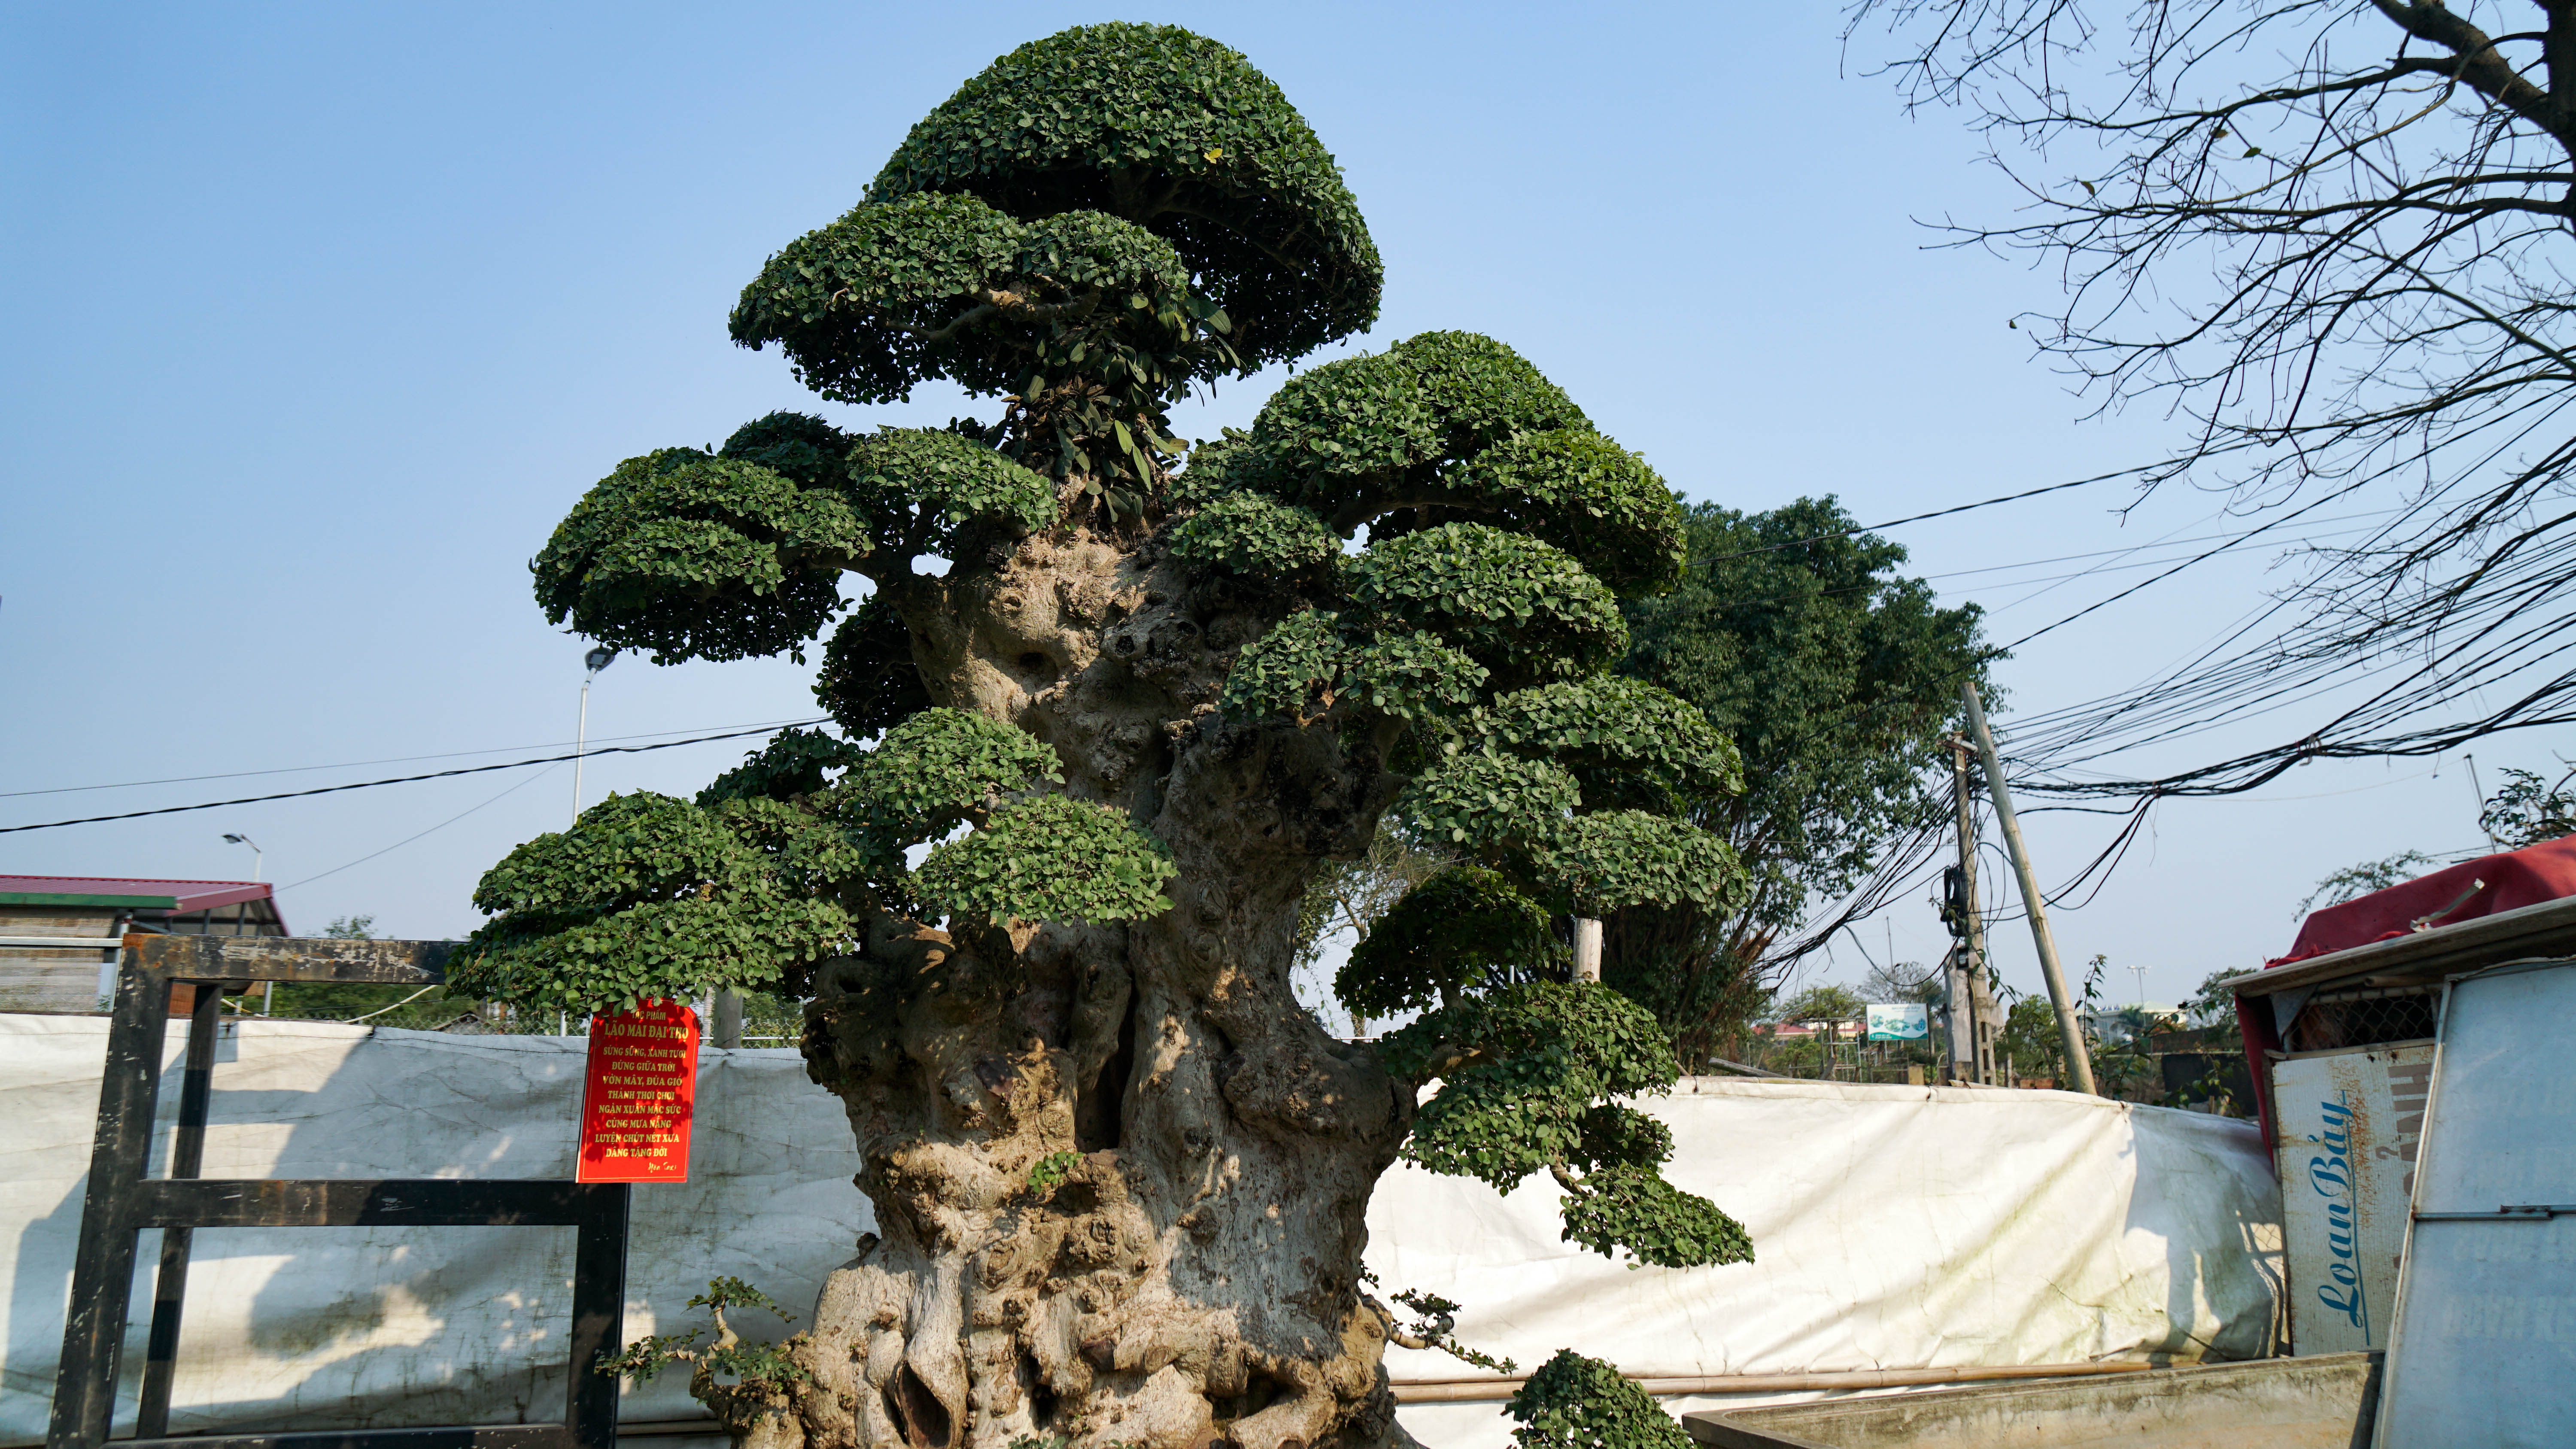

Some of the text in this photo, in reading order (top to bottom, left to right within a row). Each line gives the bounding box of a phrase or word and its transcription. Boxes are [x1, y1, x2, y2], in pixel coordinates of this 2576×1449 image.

[646, 1009, 666, 1021] PHẨM
[604, 1020, 689, 1042] LÃO MAI ĐẠI THỌ
[625, 1045, 647, 1058] SỮNG,
[647, 1048, 668, 1057] XANH
[669, 1048, 686, 1059] TƯƠI
[611, 1059, 676, 1072] ĐỨNG GIỮA TRỜI
[623, 1074, 644, 1087] MÂY,
[667, 1075, 682, 1086] GIÓ
[608, 1088, 675, 1100] THẢNH THƠI CHƠI
[623, 1103, 646, 1114] XUÂN
[647, 1103, 664, 1116] MẶC
[665, 1103, 681, 1114] SỨC
[629, 1118, 648, 1128] MƯA
[649, 1116, 671, 1128] NẮNG
[595, 1132, 680, 1144] LUYỆN CHÚT NÉT XƯA
[605, 1145, 668, 1158] DÂNG TẶNG ĐỜI
[2307, 1091, 2362, 1327] Loan Bảy
